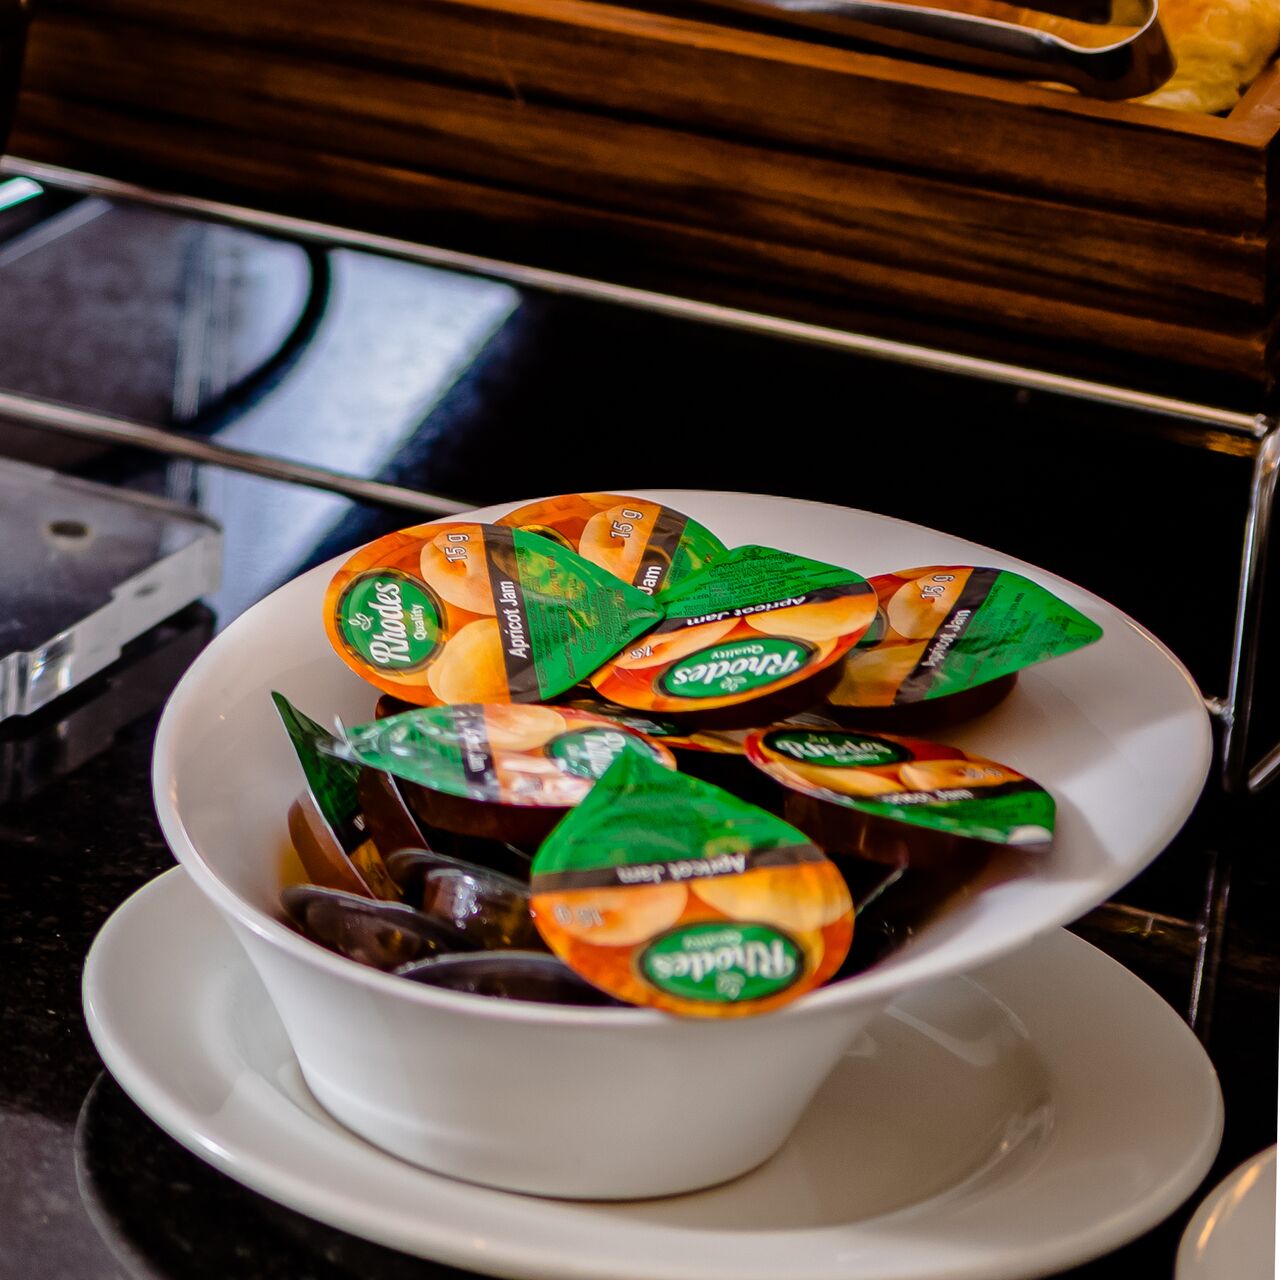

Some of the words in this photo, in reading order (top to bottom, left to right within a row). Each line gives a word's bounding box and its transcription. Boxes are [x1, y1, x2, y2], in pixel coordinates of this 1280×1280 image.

[609, 517, 635, 541] 15
[443, 540, 467, 564] 15
[499, 580, 520, 607] Jam
[733, 595, 807, 617] Apricot
[368, 580, 412, 665] Rhodes
[409, 603, 425, 642] Quality
[686, 610, 731, 626] Jam
[502, 608, 531, 660] Apricot
[710, 644, 765, 660] Quality
[672, 648, 801, 686] Rhodes
[616, 863, 667, 884] Jam
[667, 853, 747, 881] Apricot
[650, 939, 797, 982] Rhodes
